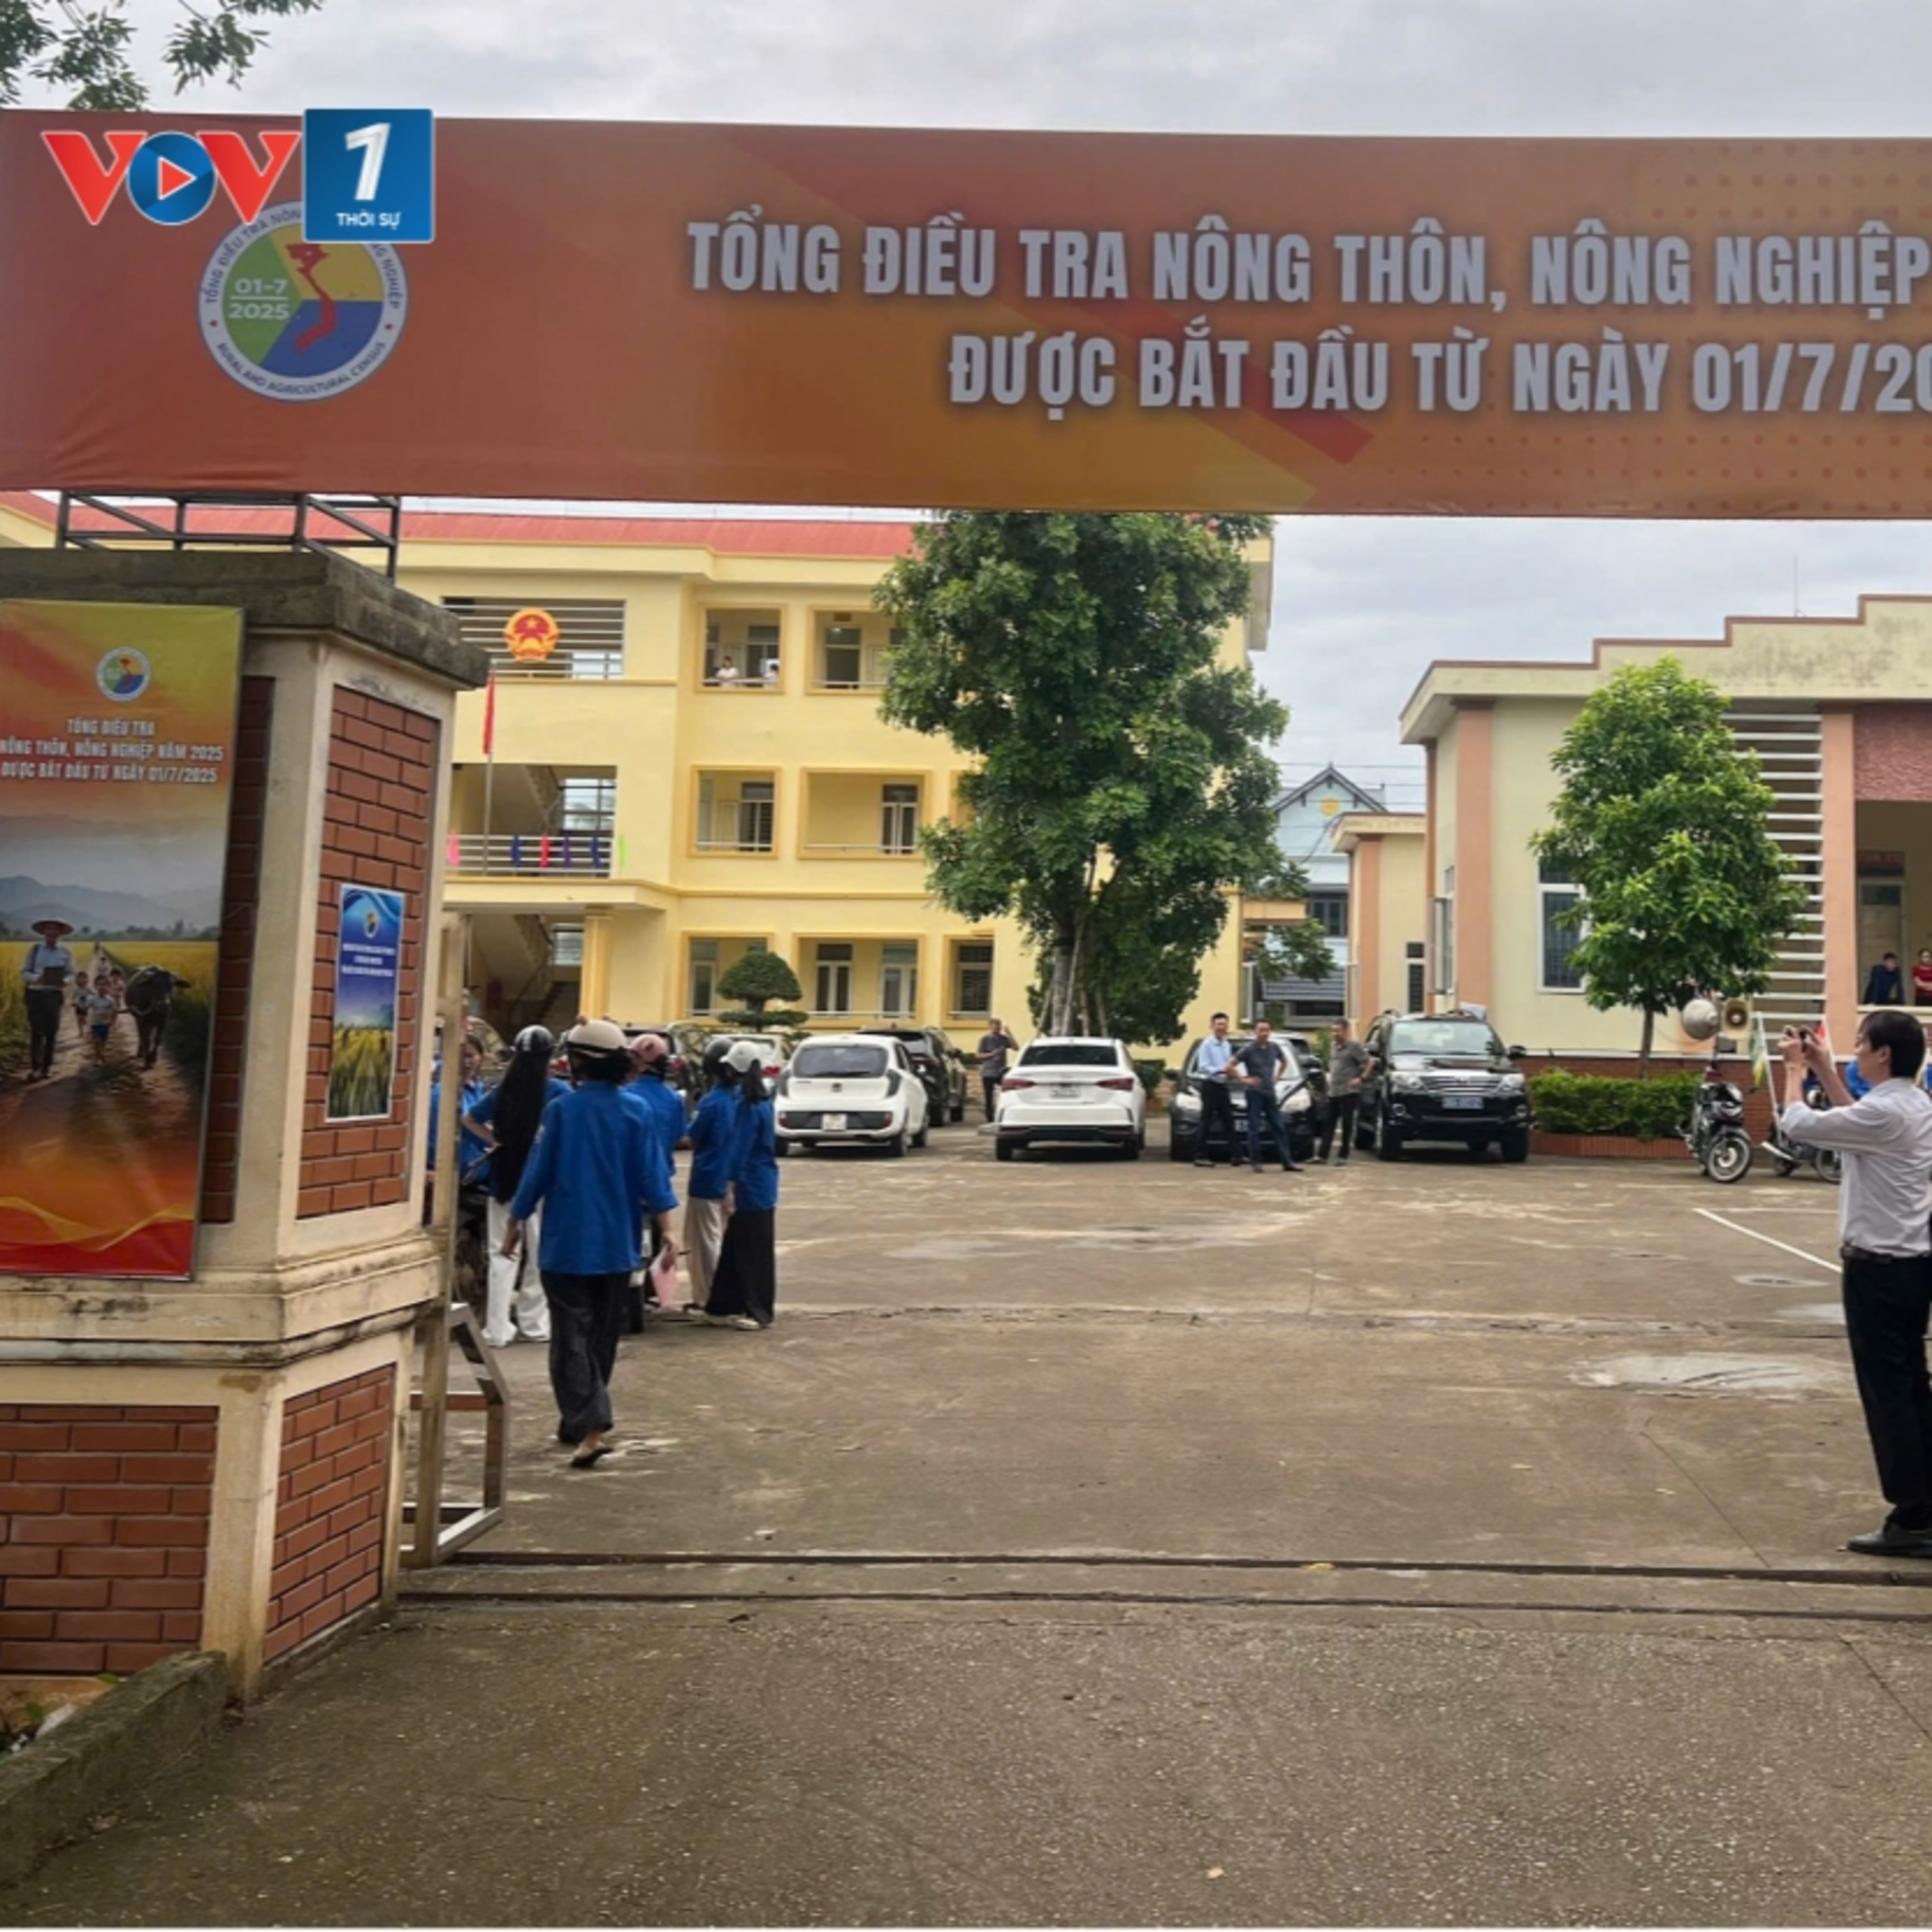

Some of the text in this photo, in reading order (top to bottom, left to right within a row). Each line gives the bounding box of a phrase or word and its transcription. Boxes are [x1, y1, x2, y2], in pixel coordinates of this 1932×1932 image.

[242, 220, 268, 238] TRA
[270, 209, 301, 223] NÔN
[687, 204, 1931, 320] TỔNG ĐIỀU TRA NÔNG THÔN, NÔNG NGHIỆP
[235, 278, 287, 294] 01-7
[229, 303, 290, 319] 2025
[216, 343, 242, 373] RURAL
[243, 370, 267, 386] AND
[949, 331, 1115, 421] ĐƯỢC
[1139, 315, 1250, 408] BẮT
[1271, 325, 1388, 410] ĐẦU
[1412, 325, 1489, 412] TỪ
[1513, 326, 1670, 412] NGÀY
